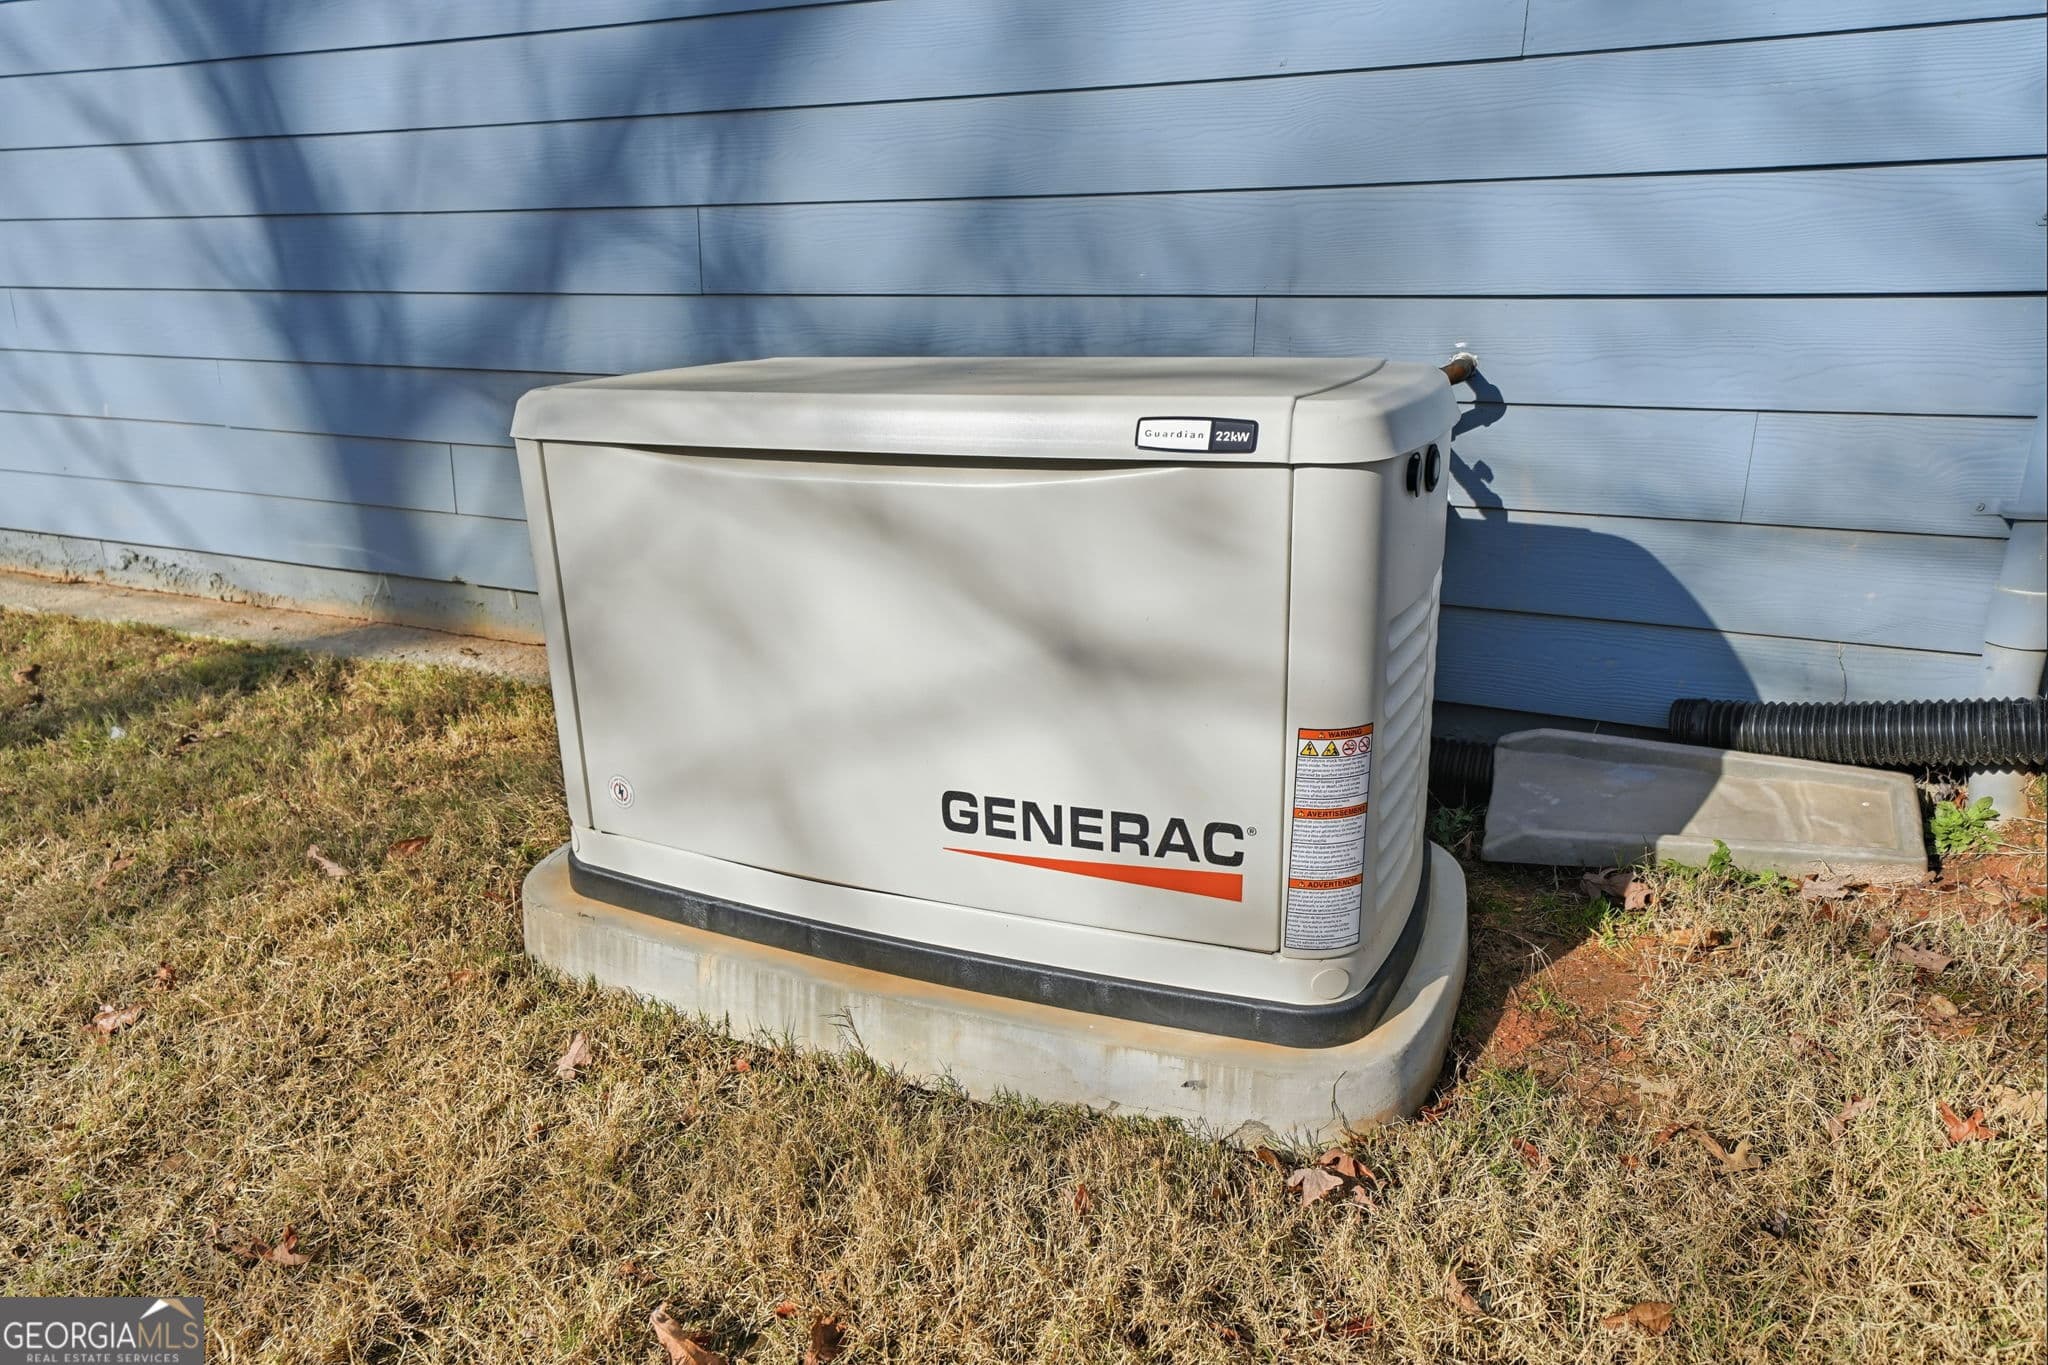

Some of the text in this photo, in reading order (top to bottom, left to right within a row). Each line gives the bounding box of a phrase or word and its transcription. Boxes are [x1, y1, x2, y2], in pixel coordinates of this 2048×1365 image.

[1145, 429, 1250, 442] Guardian 22kW
[1328, 727, 1362, 738] WARNING
[1307, 805, 1366, 817] AVERTISSEMENT
